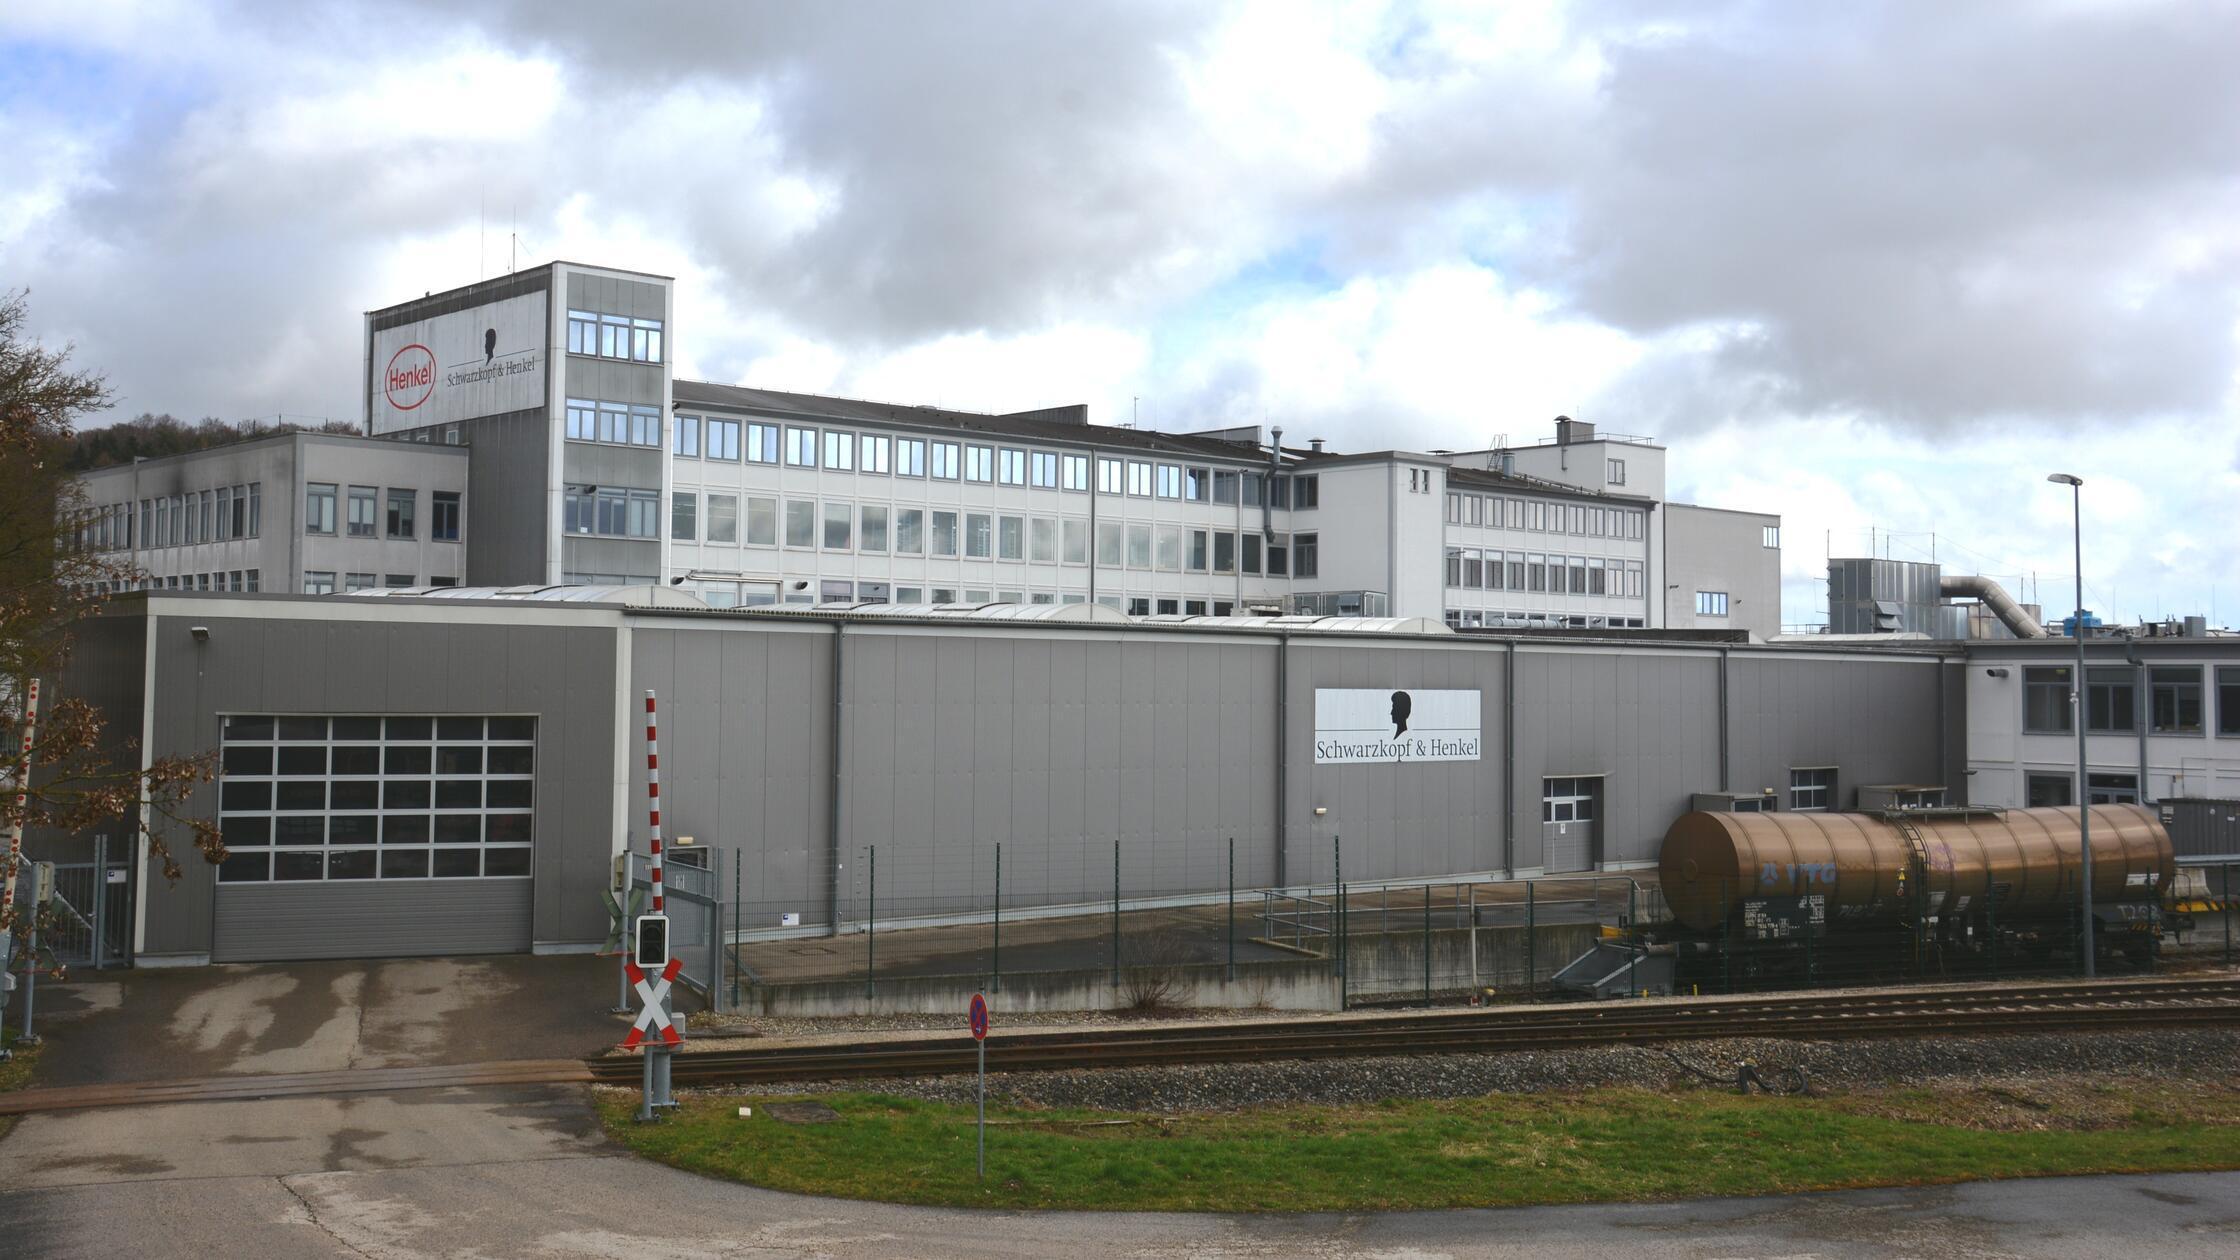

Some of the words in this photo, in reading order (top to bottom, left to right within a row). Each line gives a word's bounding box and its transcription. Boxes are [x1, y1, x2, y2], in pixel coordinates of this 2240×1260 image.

[389, 363, 432, 391] Henkel
[447, 364, 498, 388] Schwarzkopf
[497, 365, 505, 377] &
[506, 356, 535, 376] Henkel
[1317, 739, 1413, 761] Schwarzkopf
[1416, 738, 1426, 756] &
[1431, 738, 1478, 756] Henkel
[1786, 864, 1836, 885] VTG
